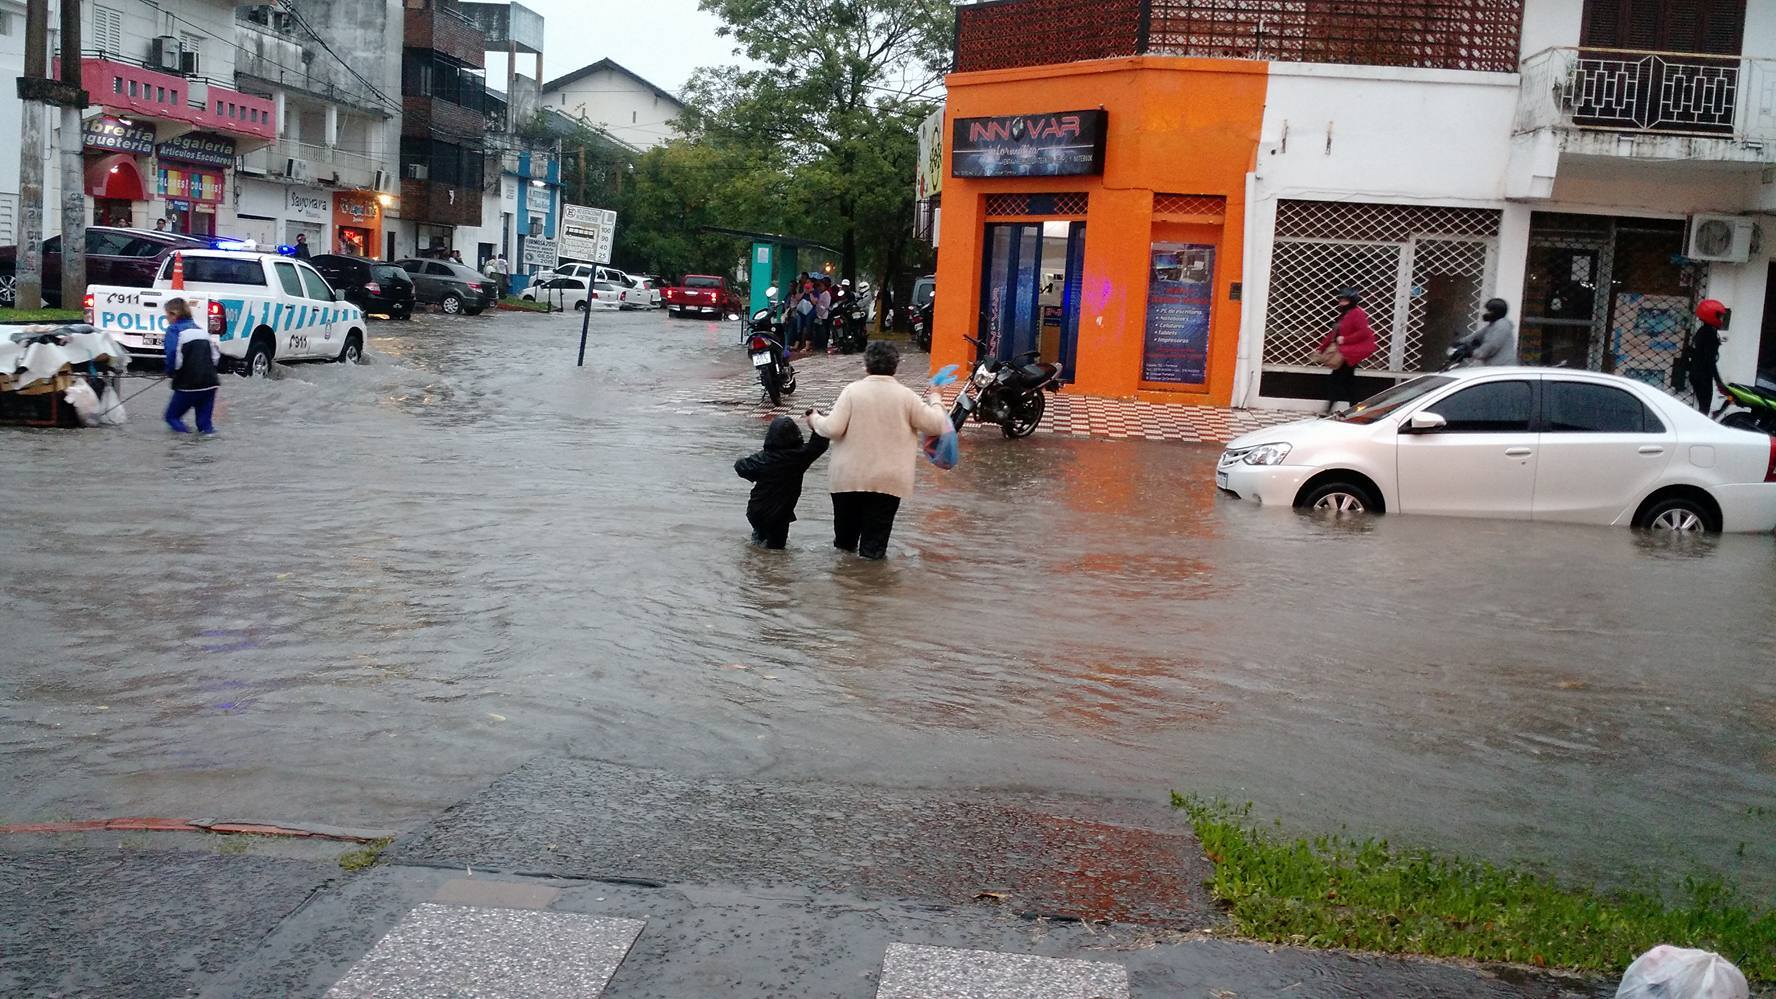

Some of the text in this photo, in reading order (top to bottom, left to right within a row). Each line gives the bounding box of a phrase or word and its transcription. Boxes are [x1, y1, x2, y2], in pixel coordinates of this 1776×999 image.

[969, 116, 1080, 142] INNOVAR
[168, 136, 233, 155] egalería
[118, 294, 139, 304] 911
[102, 312, 168, 331] POLIC
[294, 336, 307, 348] 911
